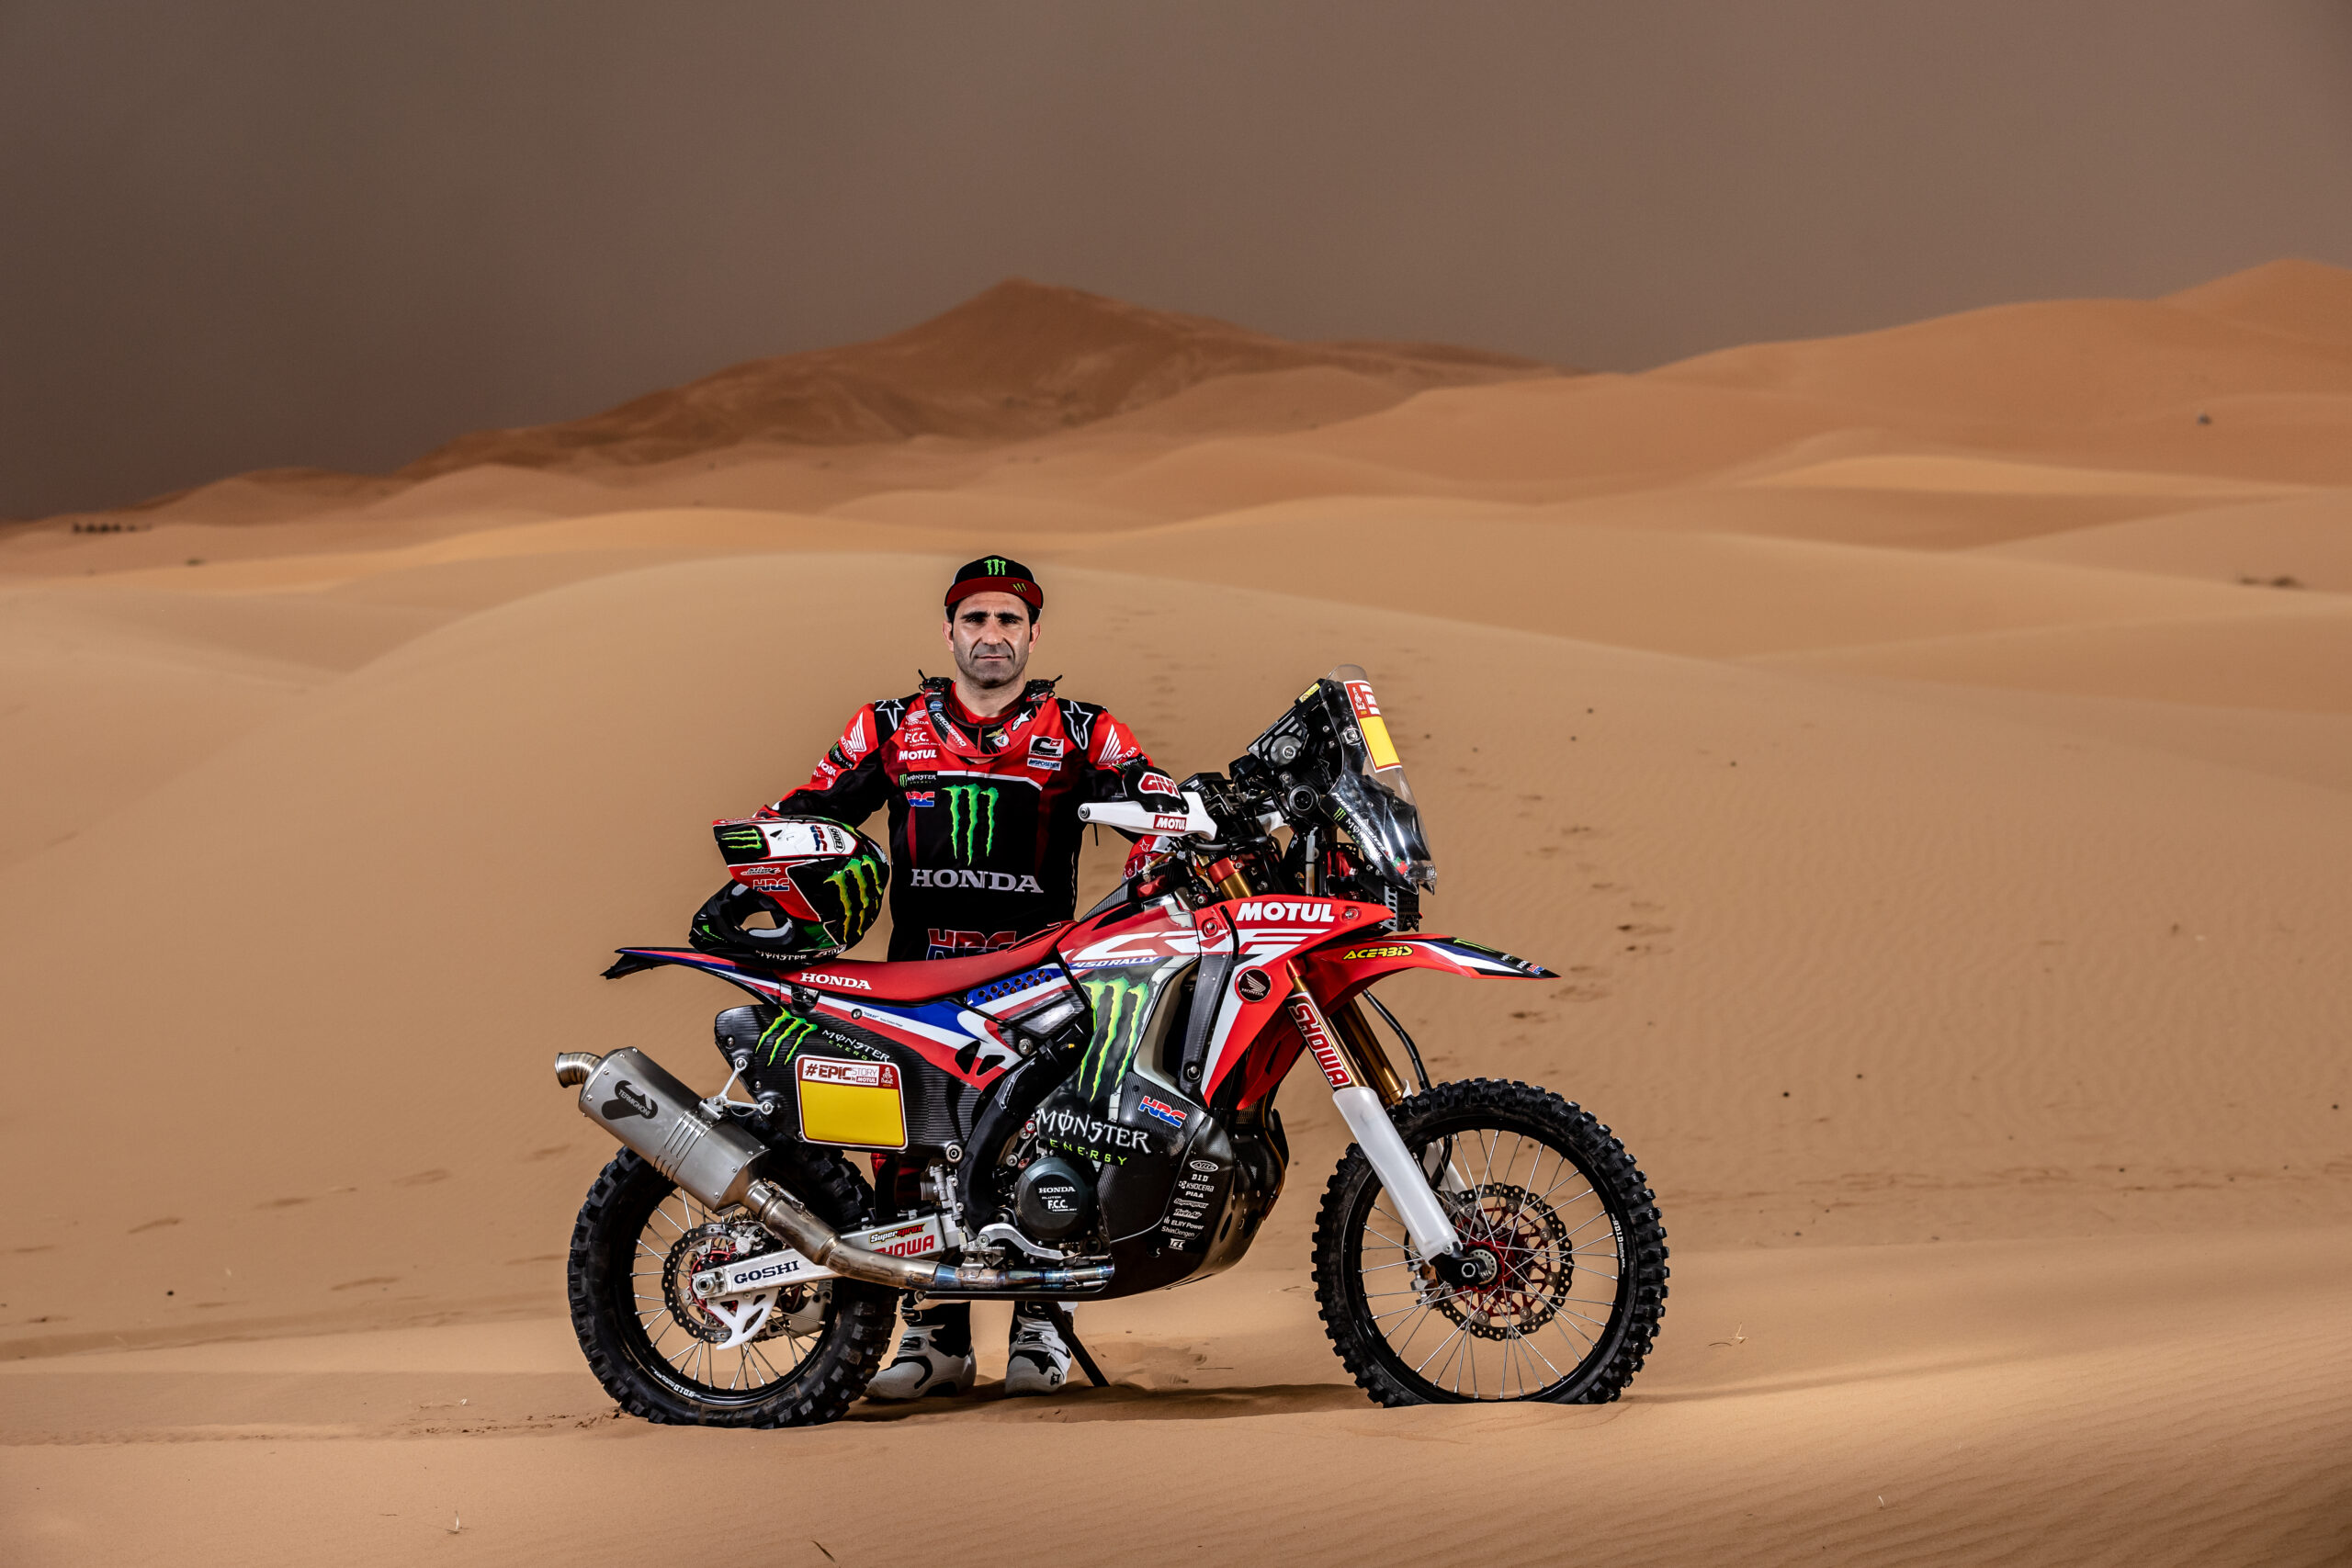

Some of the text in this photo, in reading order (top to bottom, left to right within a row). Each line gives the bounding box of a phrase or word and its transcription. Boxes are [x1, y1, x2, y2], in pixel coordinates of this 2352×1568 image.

[899, 750, 937, 761] MOTUL
[910, 868, 1045, 894] HONDA
[1236, 902, 1336, 922] MOTUL
[800, 972, 873, 990] HONDA
[822, 1029, 890, 1063] MONSTER
[828, 1040, 873, 1062] ENERG
[1288, 1003, 1351, 1088] SHOWA
[618, 1089, 651, 1117] TERMIGNONI
[1036, 1107, 1151, 1154] MONSTER
[1050, 1138, 1127, 1166] ENERGY
[1038, 1186, 1076, 1194] HONDA
[1185, 1190, 1204, 1199] PIAA
[734, 1259, 800, 1284] GOSHI
